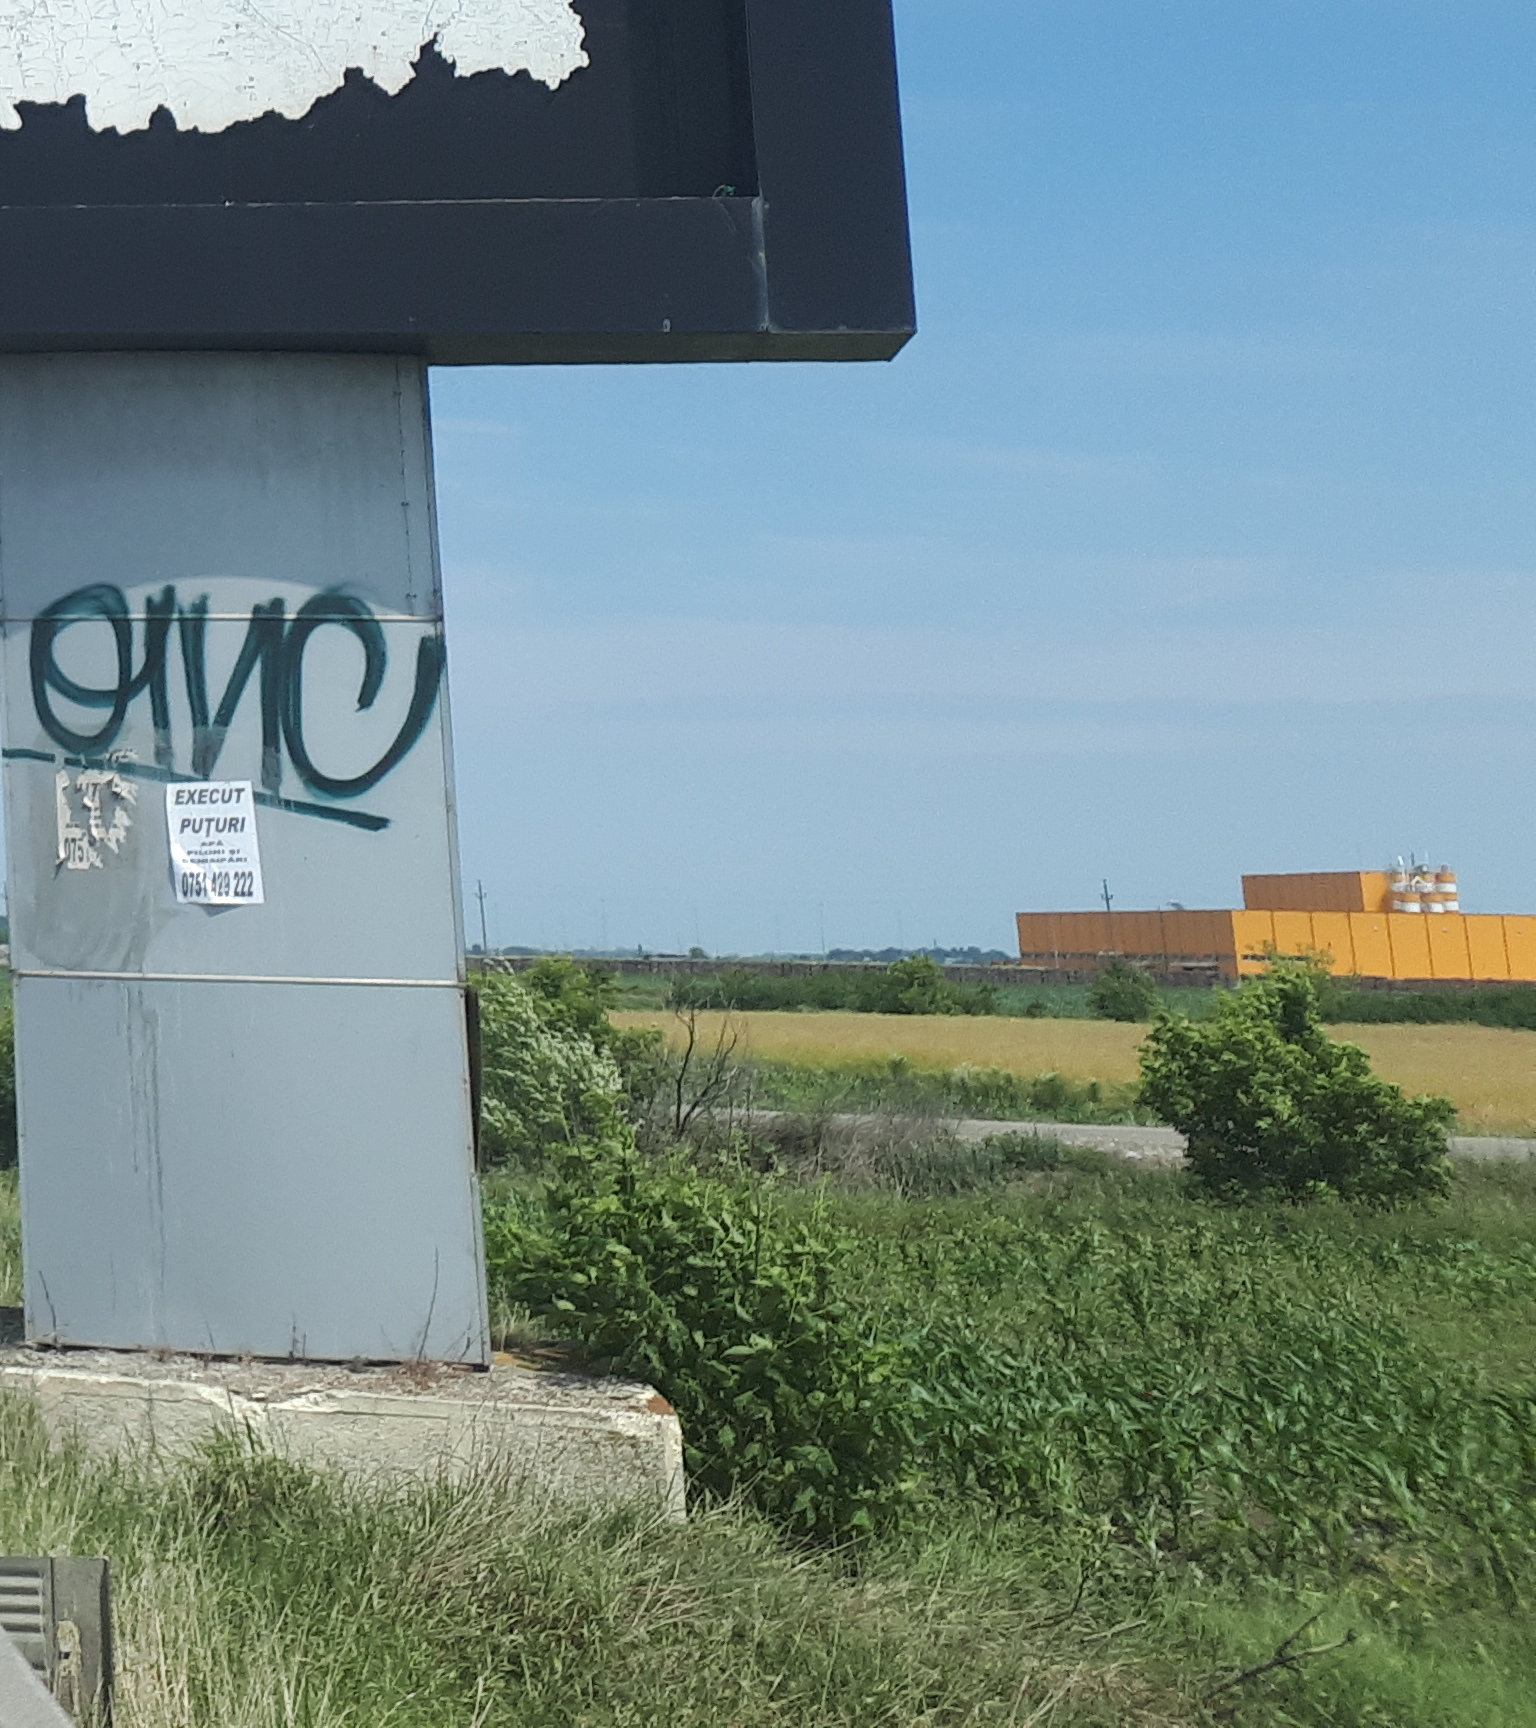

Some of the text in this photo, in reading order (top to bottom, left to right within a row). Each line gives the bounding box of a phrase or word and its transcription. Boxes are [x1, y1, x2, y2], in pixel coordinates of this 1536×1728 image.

[175, 788, 246, 806] EXECUT
[181, 871, 208, 898] 0751
[233, 870, 254, 898] 222
